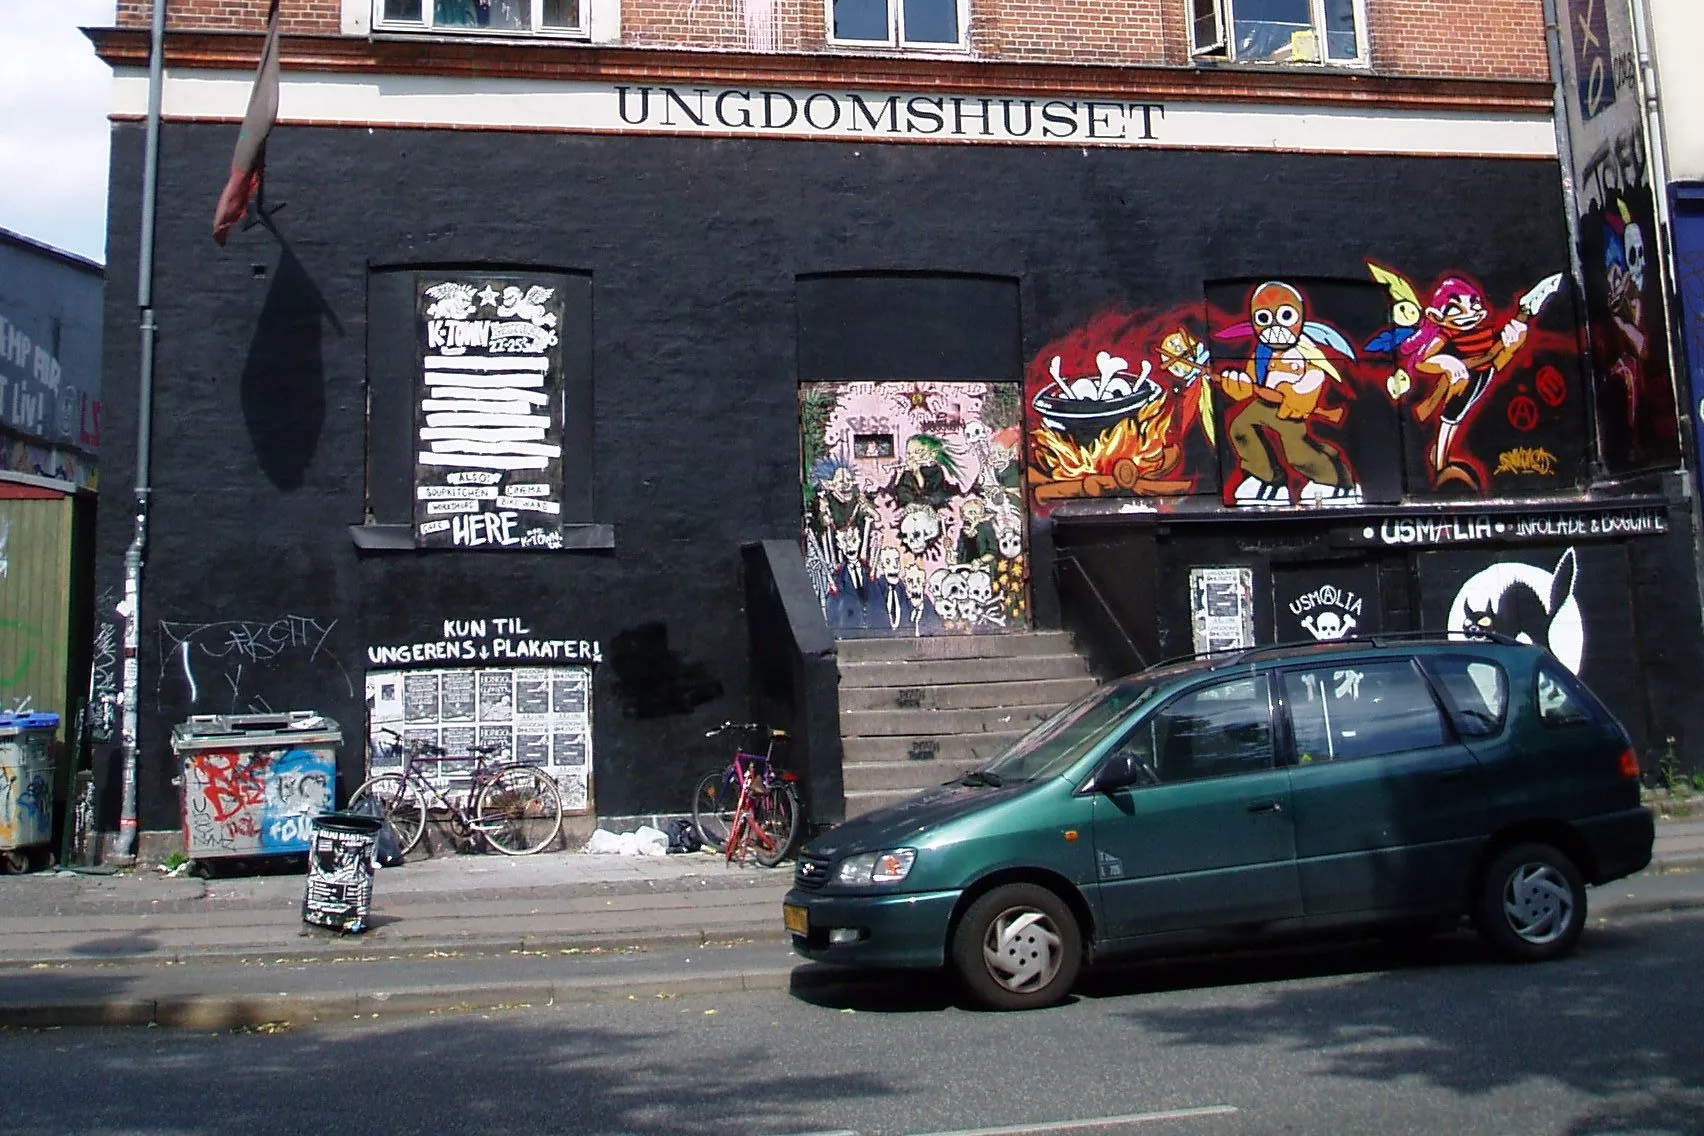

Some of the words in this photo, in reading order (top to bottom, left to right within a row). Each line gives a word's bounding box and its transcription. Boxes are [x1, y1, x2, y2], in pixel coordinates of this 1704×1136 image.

[614, 86, 1165, 140] UNGDOMSHUSET
[452, 511, 520, 546] HERE
[1381, 517, 1492, 544] USMALIA
[1289, 585, 1362, 616] USMALIA
[443, 619, 486, 638] KUN
[493, 617, 530, 635] TIL
[368, 640, 476, 663] UNGERENS
